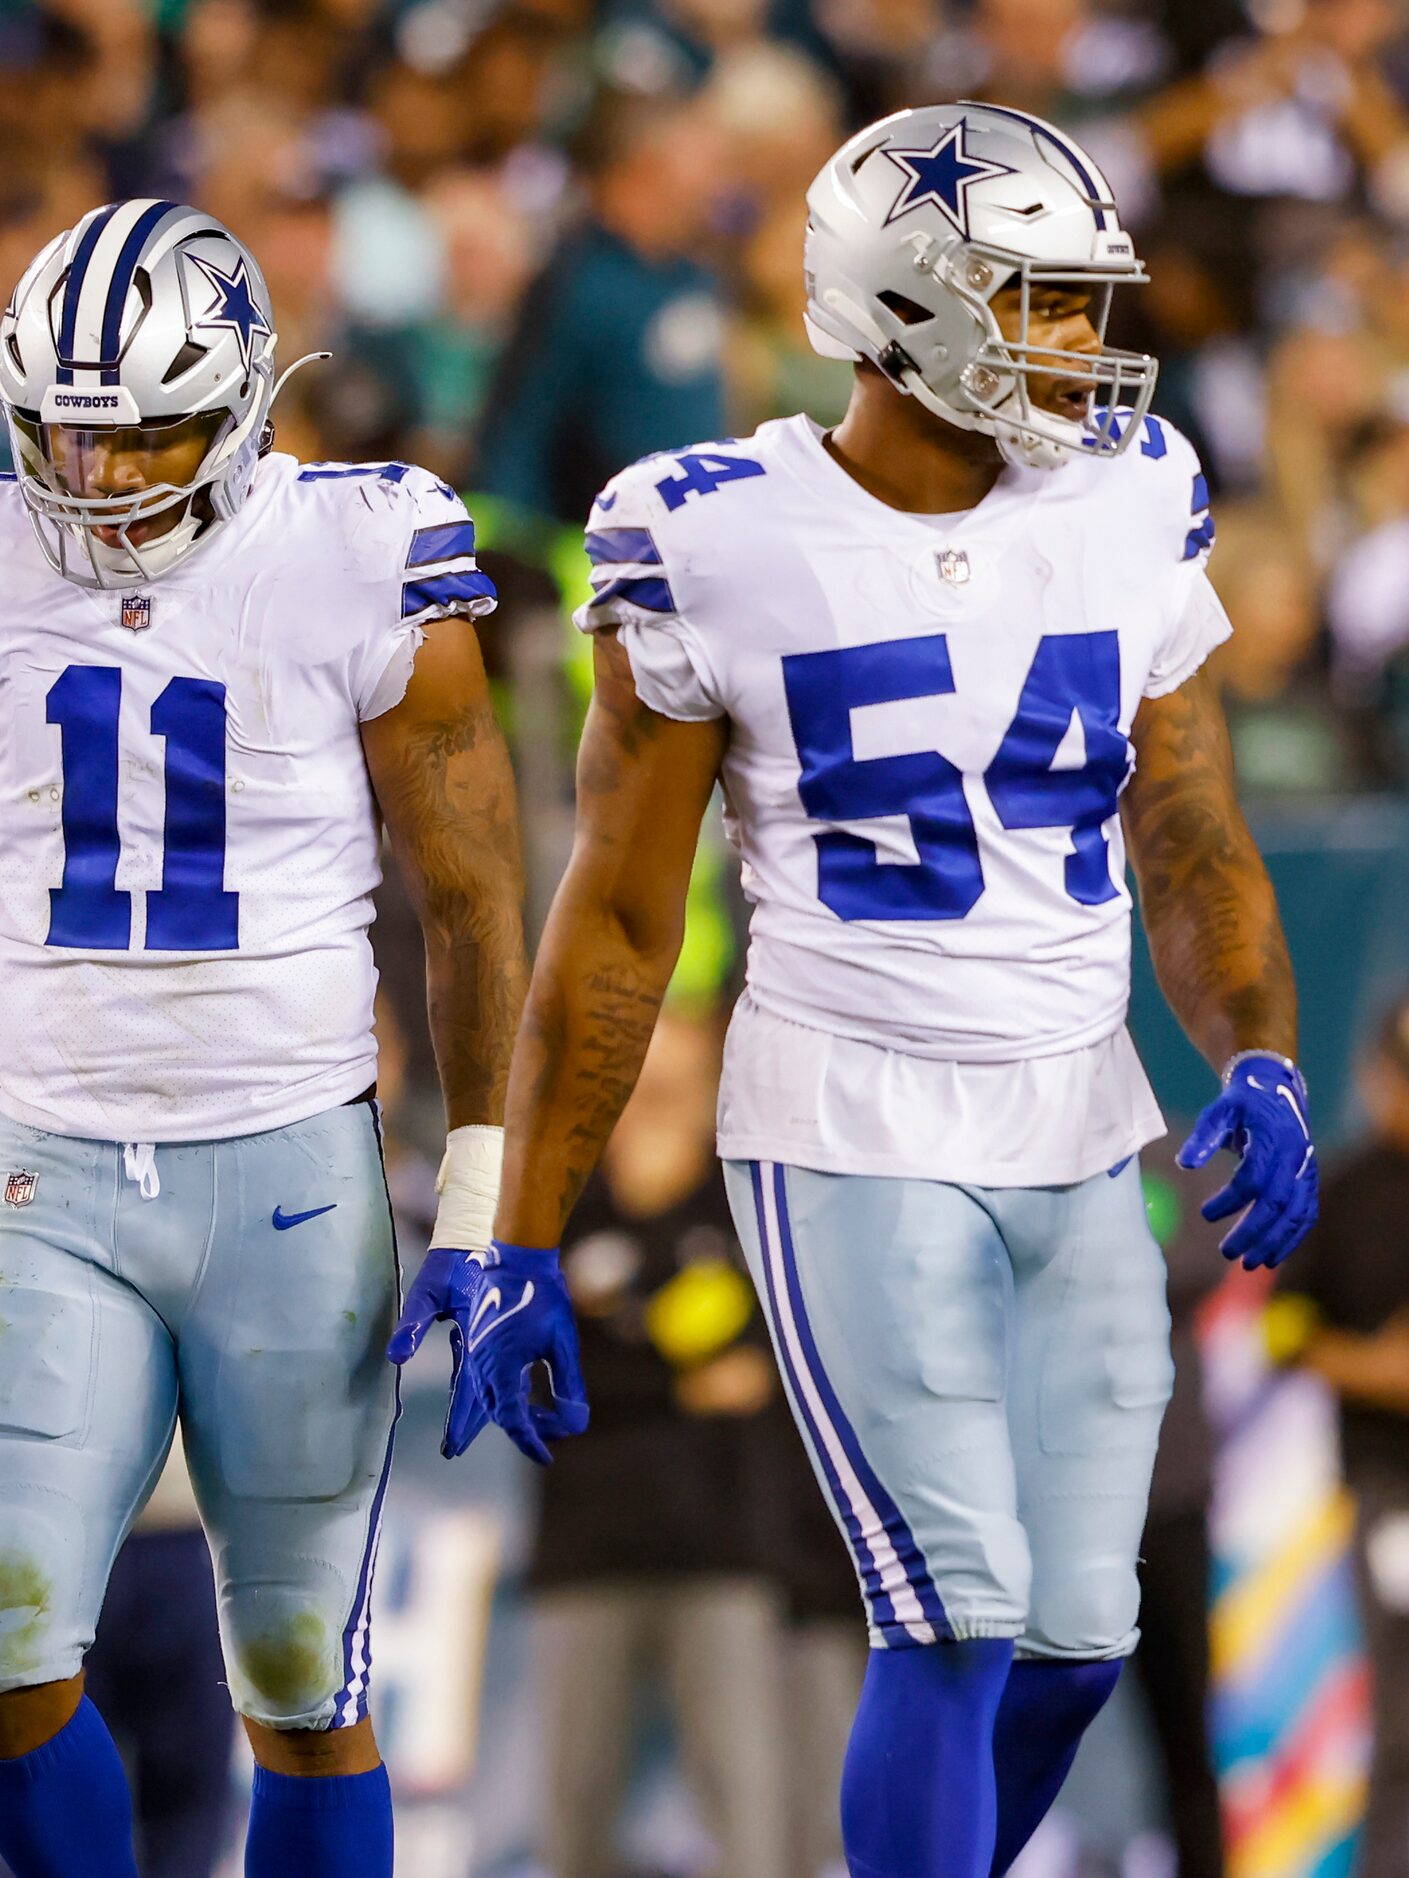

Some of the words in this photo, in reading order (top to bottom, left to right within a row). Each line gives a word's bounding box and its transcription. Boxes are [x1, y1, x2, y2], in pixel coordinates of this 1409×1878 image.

[54, 394, 118, 408] COWBOYS
[124, 610, 147, 627] NFL
[781, 629, 1130, 922] 54
[44, 664, 240, 951] 11
[8, 1186, 29, 1201] NFL
